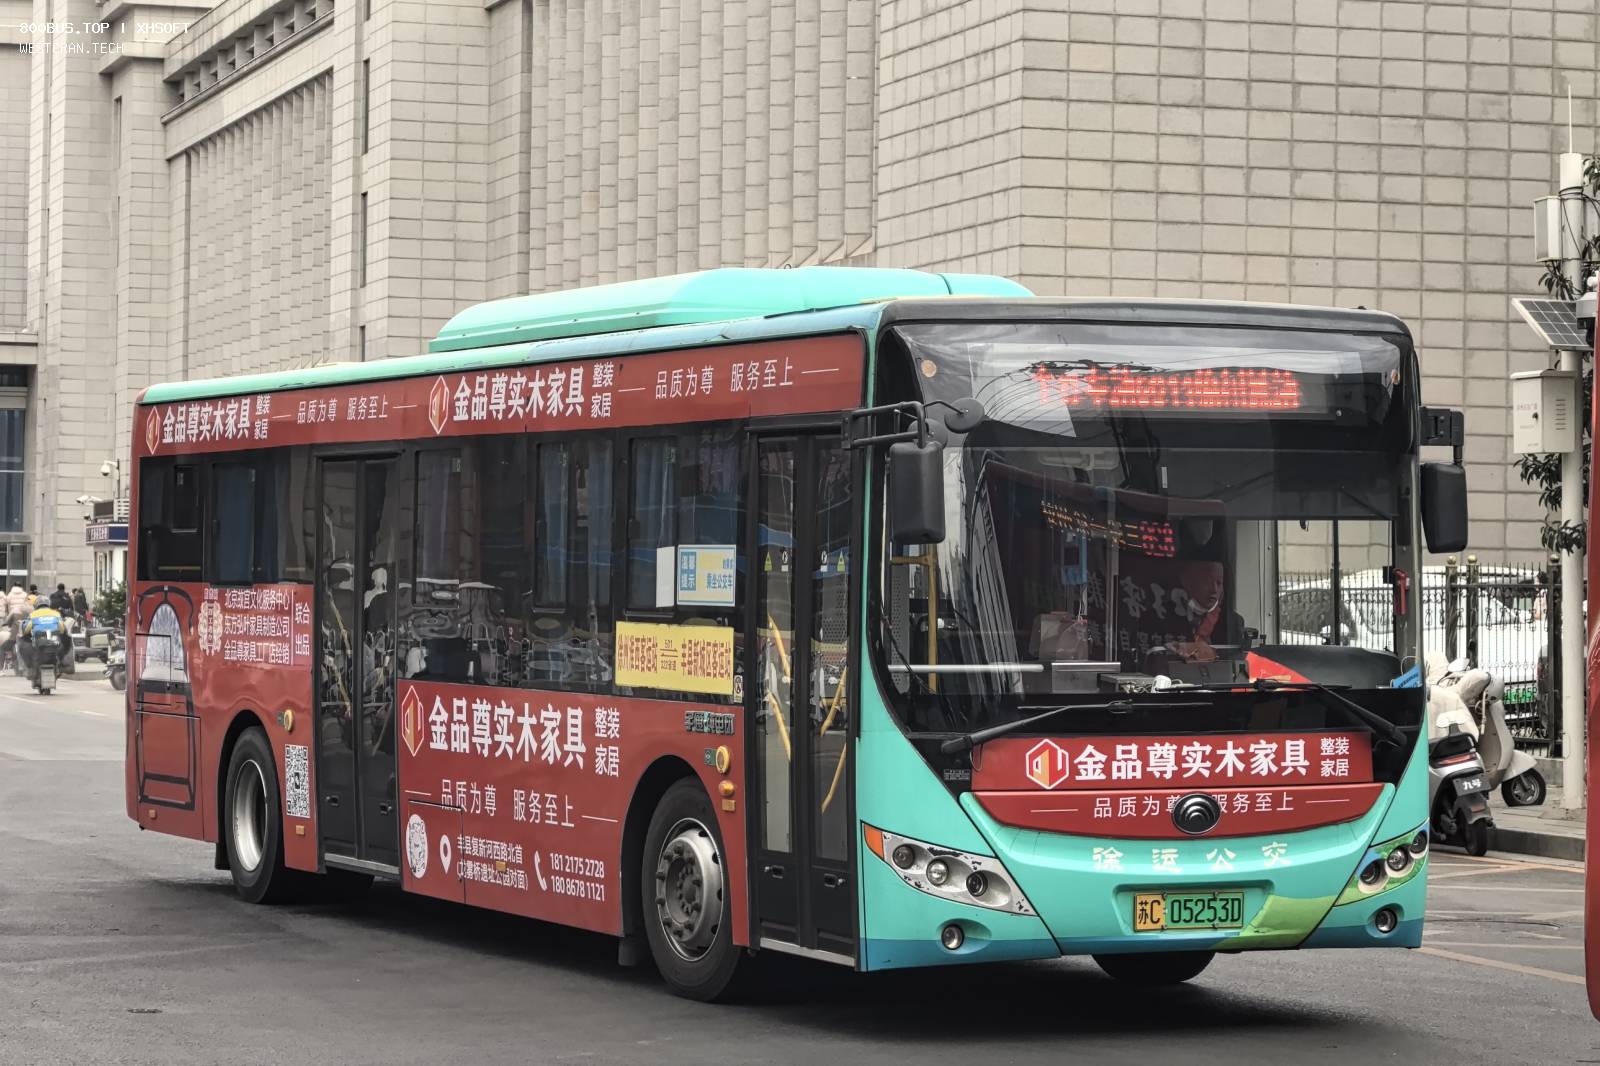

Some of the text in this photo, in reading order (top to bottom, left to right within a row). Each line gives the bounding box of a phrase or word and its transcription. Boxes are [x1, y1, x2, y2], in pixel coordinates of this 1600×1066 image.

[593, 361, 614, 388] 整装
[655, 356, 793, 400] 品质为尊 服务至上
[255, 395, 271, 416] 整装
[453, 367, 585, 422] 金品尊实木家具
[590, 392, 612, 418] 家居
[162, 399, 251, 444] 金品尊实木家具
[297, 397, 388, 424] 品质为尊 服务至上
[254, 419, 268, 440] 家居
[295, 602, 310, 625] 联合
[295, 633, 310, 656] 出品
[428, 695, 587, 769] 金品尊实木家具
[594, 706, 620, 739] 整装
[1073, 739, 1310, 781] 金品尊实木家具
[1320, 737, 1350, 756] 整装
[594, 745, 620, 777] 家居
[1320, 758, 1350, 777] 家居
[1462, 778, 1482, 790] 九号
[441, 779, 575, 828] 品质为尊 服务至上
[550, 853, 605, 878] 181 2175 2728
[1092, 841, 1293, 874] 徐运公交
[551, 875, 605, 902] 180 8678 1121
